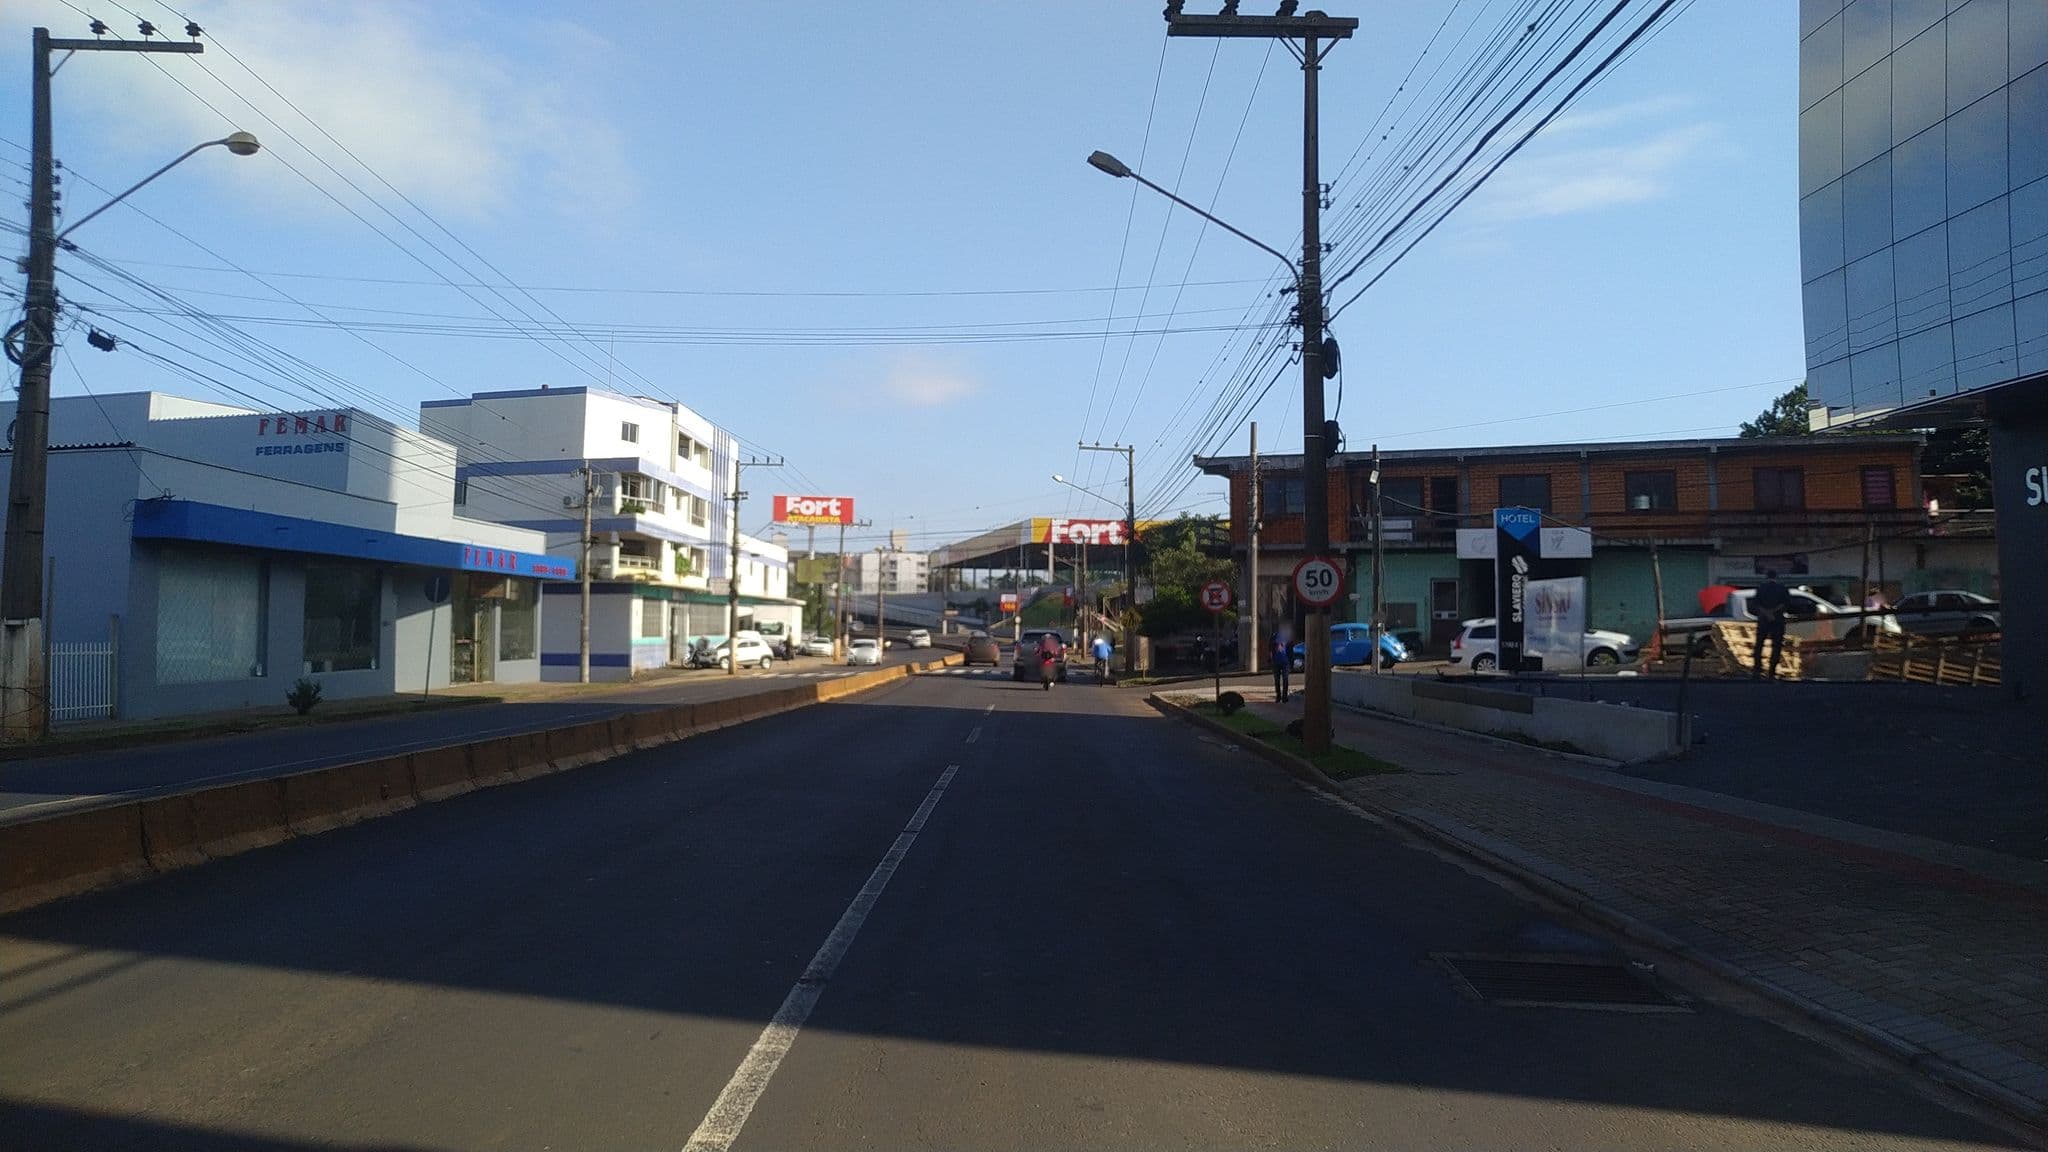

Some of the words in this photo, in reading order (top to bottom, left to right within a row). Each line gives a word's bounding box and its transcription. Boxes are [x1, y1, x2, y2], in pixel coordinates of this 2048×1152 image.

[257, 414, 347, 436] FEMAR
[255, 442, 345, 456] FERRAGENS
[786, 496, 841, 516] Fort
[1501, 514, 1536, 524] HOTEL
[1051, 519, 1123, 545] Fort
[1305, 569, 1333, 588] 50
[1511, 574, 1523, 623] SLAVIERO
